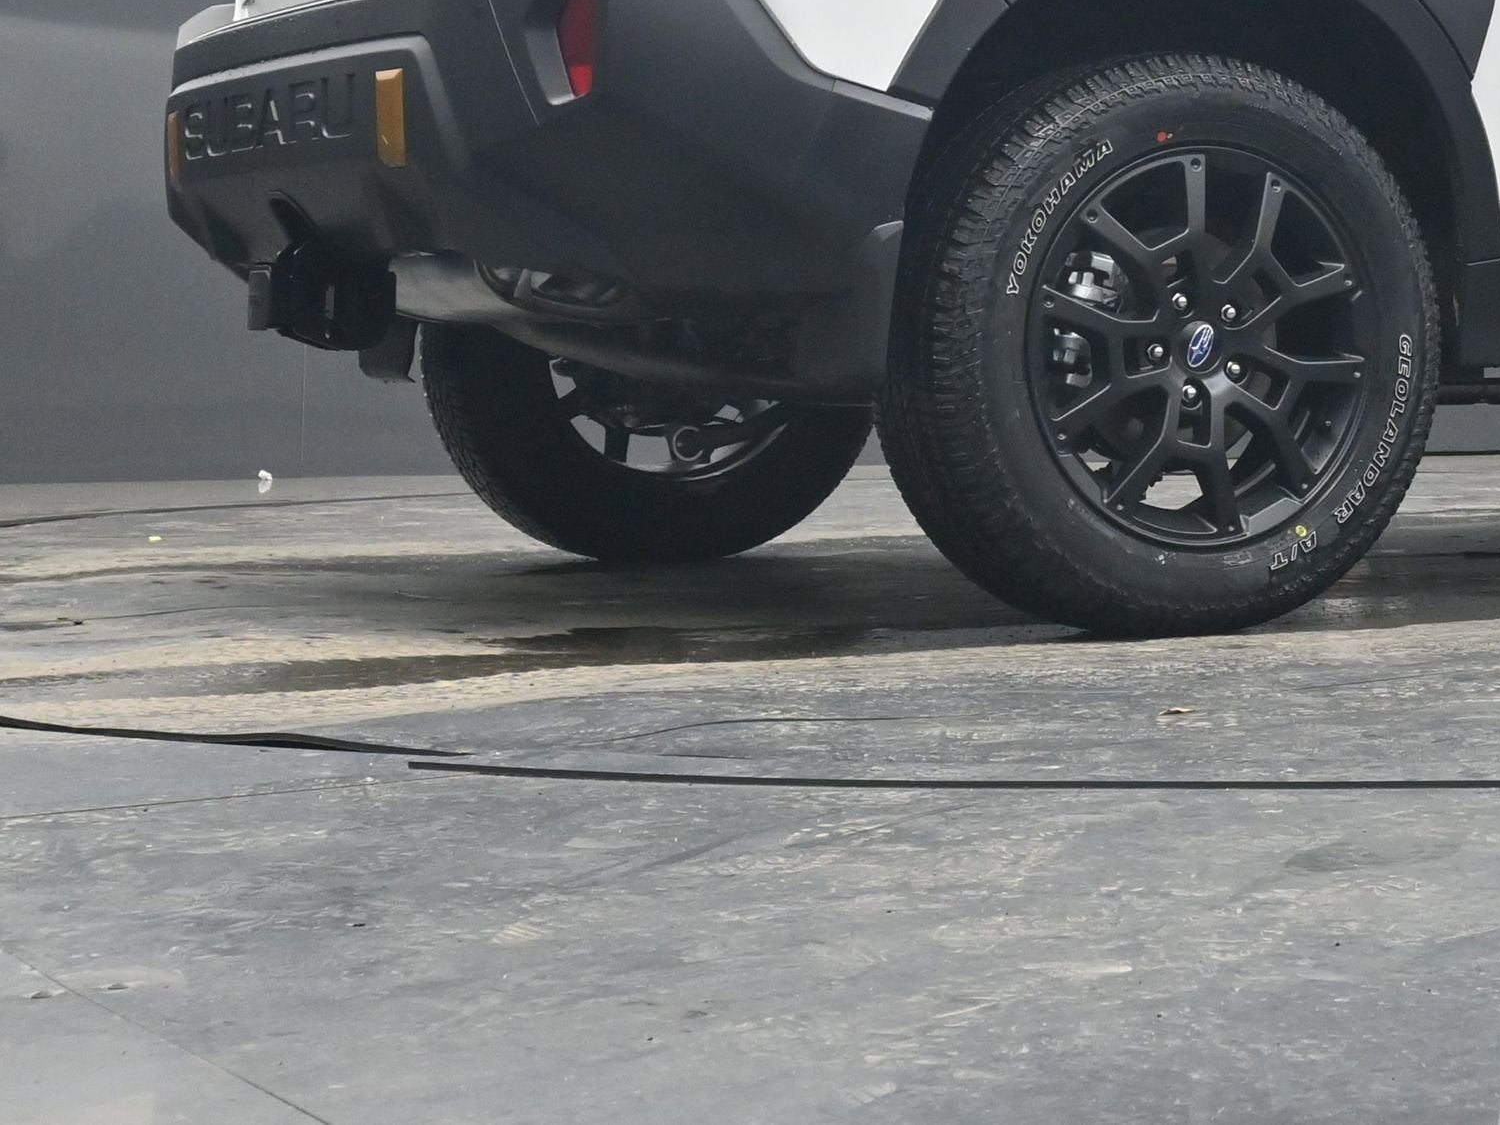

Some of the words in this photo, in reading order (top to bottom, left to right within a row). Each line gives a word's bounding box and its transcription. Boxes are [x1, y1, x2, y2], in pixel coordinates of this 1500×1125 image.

[185, 74, 355, 161] SUBARU
[1006, 139, 1113, 294] YOKOHAMA
[1333, 334, 1412, 524] GEOLANDAR
[1270, 531, 1317, 570] A/T
